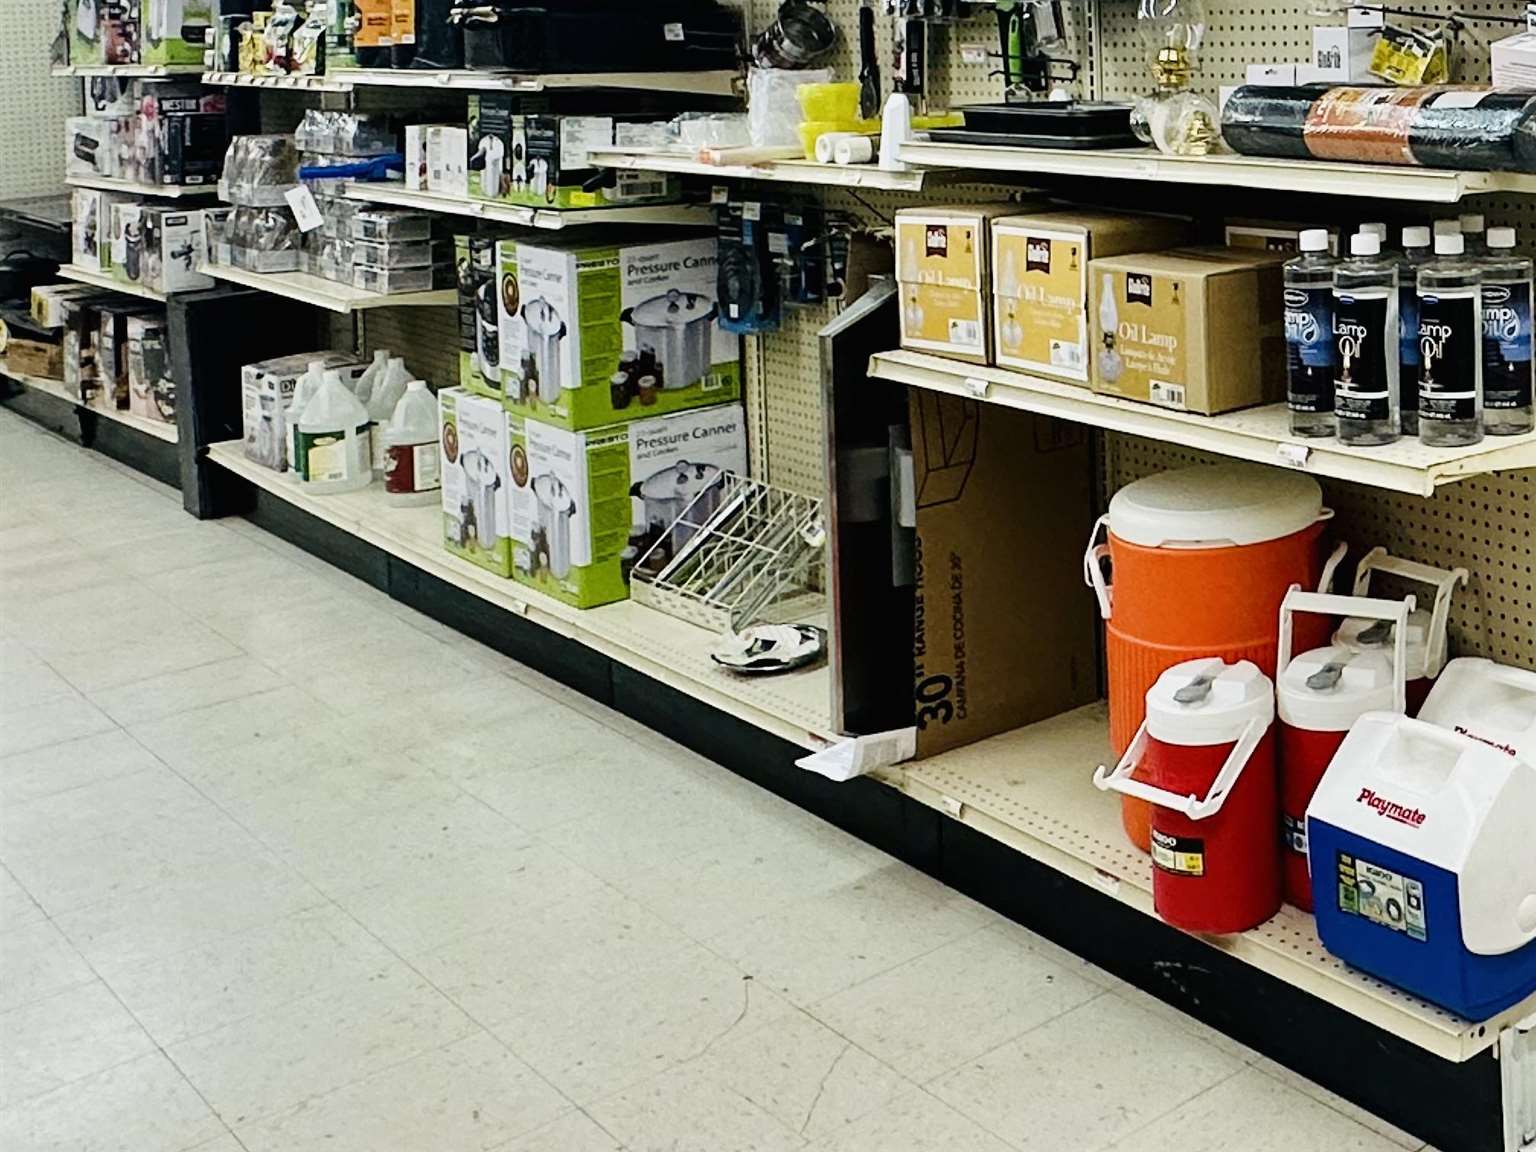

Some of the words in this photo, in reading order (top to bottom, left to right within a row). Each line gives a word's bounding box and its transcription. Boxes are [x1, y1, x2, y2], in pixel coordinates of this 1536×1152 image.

[627, 257, 681, 276] Pressure
[683, 254, 719, 269] Cann
[1142, 324, 1178, 352] Lamp
[1332, 312, 1367, 343] Lamp
[636, 431, 690, 450] Pressure
[692, 423, 738, 440] Canner
[1356, 787, 1427, 827] Playmate
